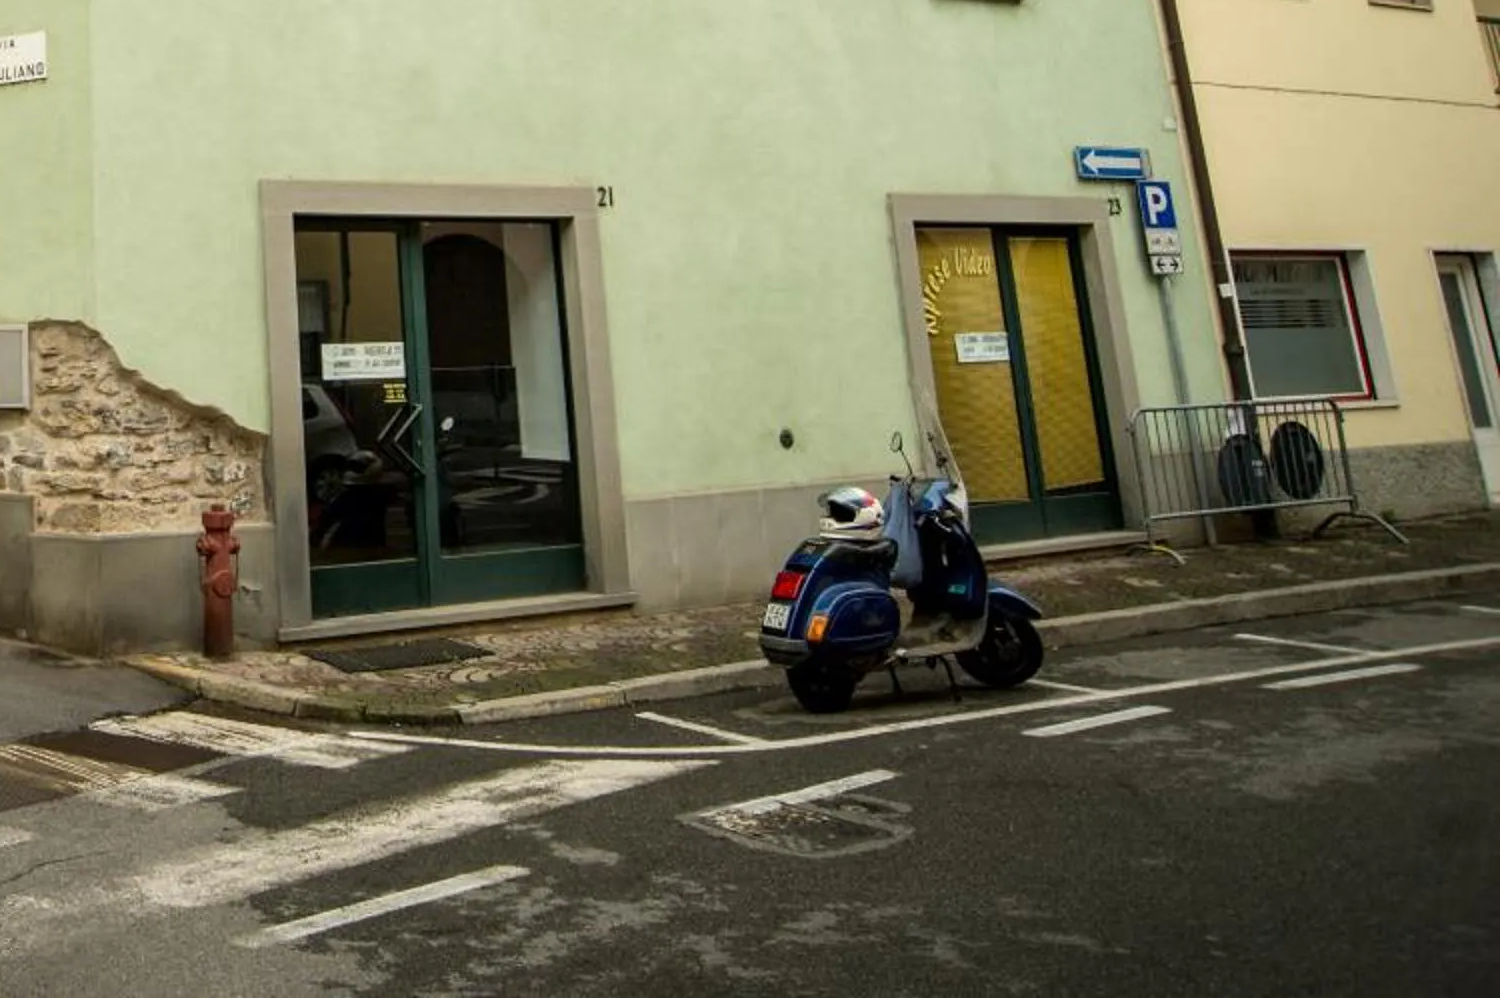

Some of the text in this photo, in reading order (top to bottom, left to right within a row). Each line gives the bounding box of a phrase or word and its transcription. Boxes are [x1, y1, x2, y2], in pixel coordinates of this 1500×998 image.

[597, 185, 613, 207] 21
[1107, 198, 1122, 216] 23
[1145, 185, 1168, 225] P
[954, 245, 991, 275] Video
